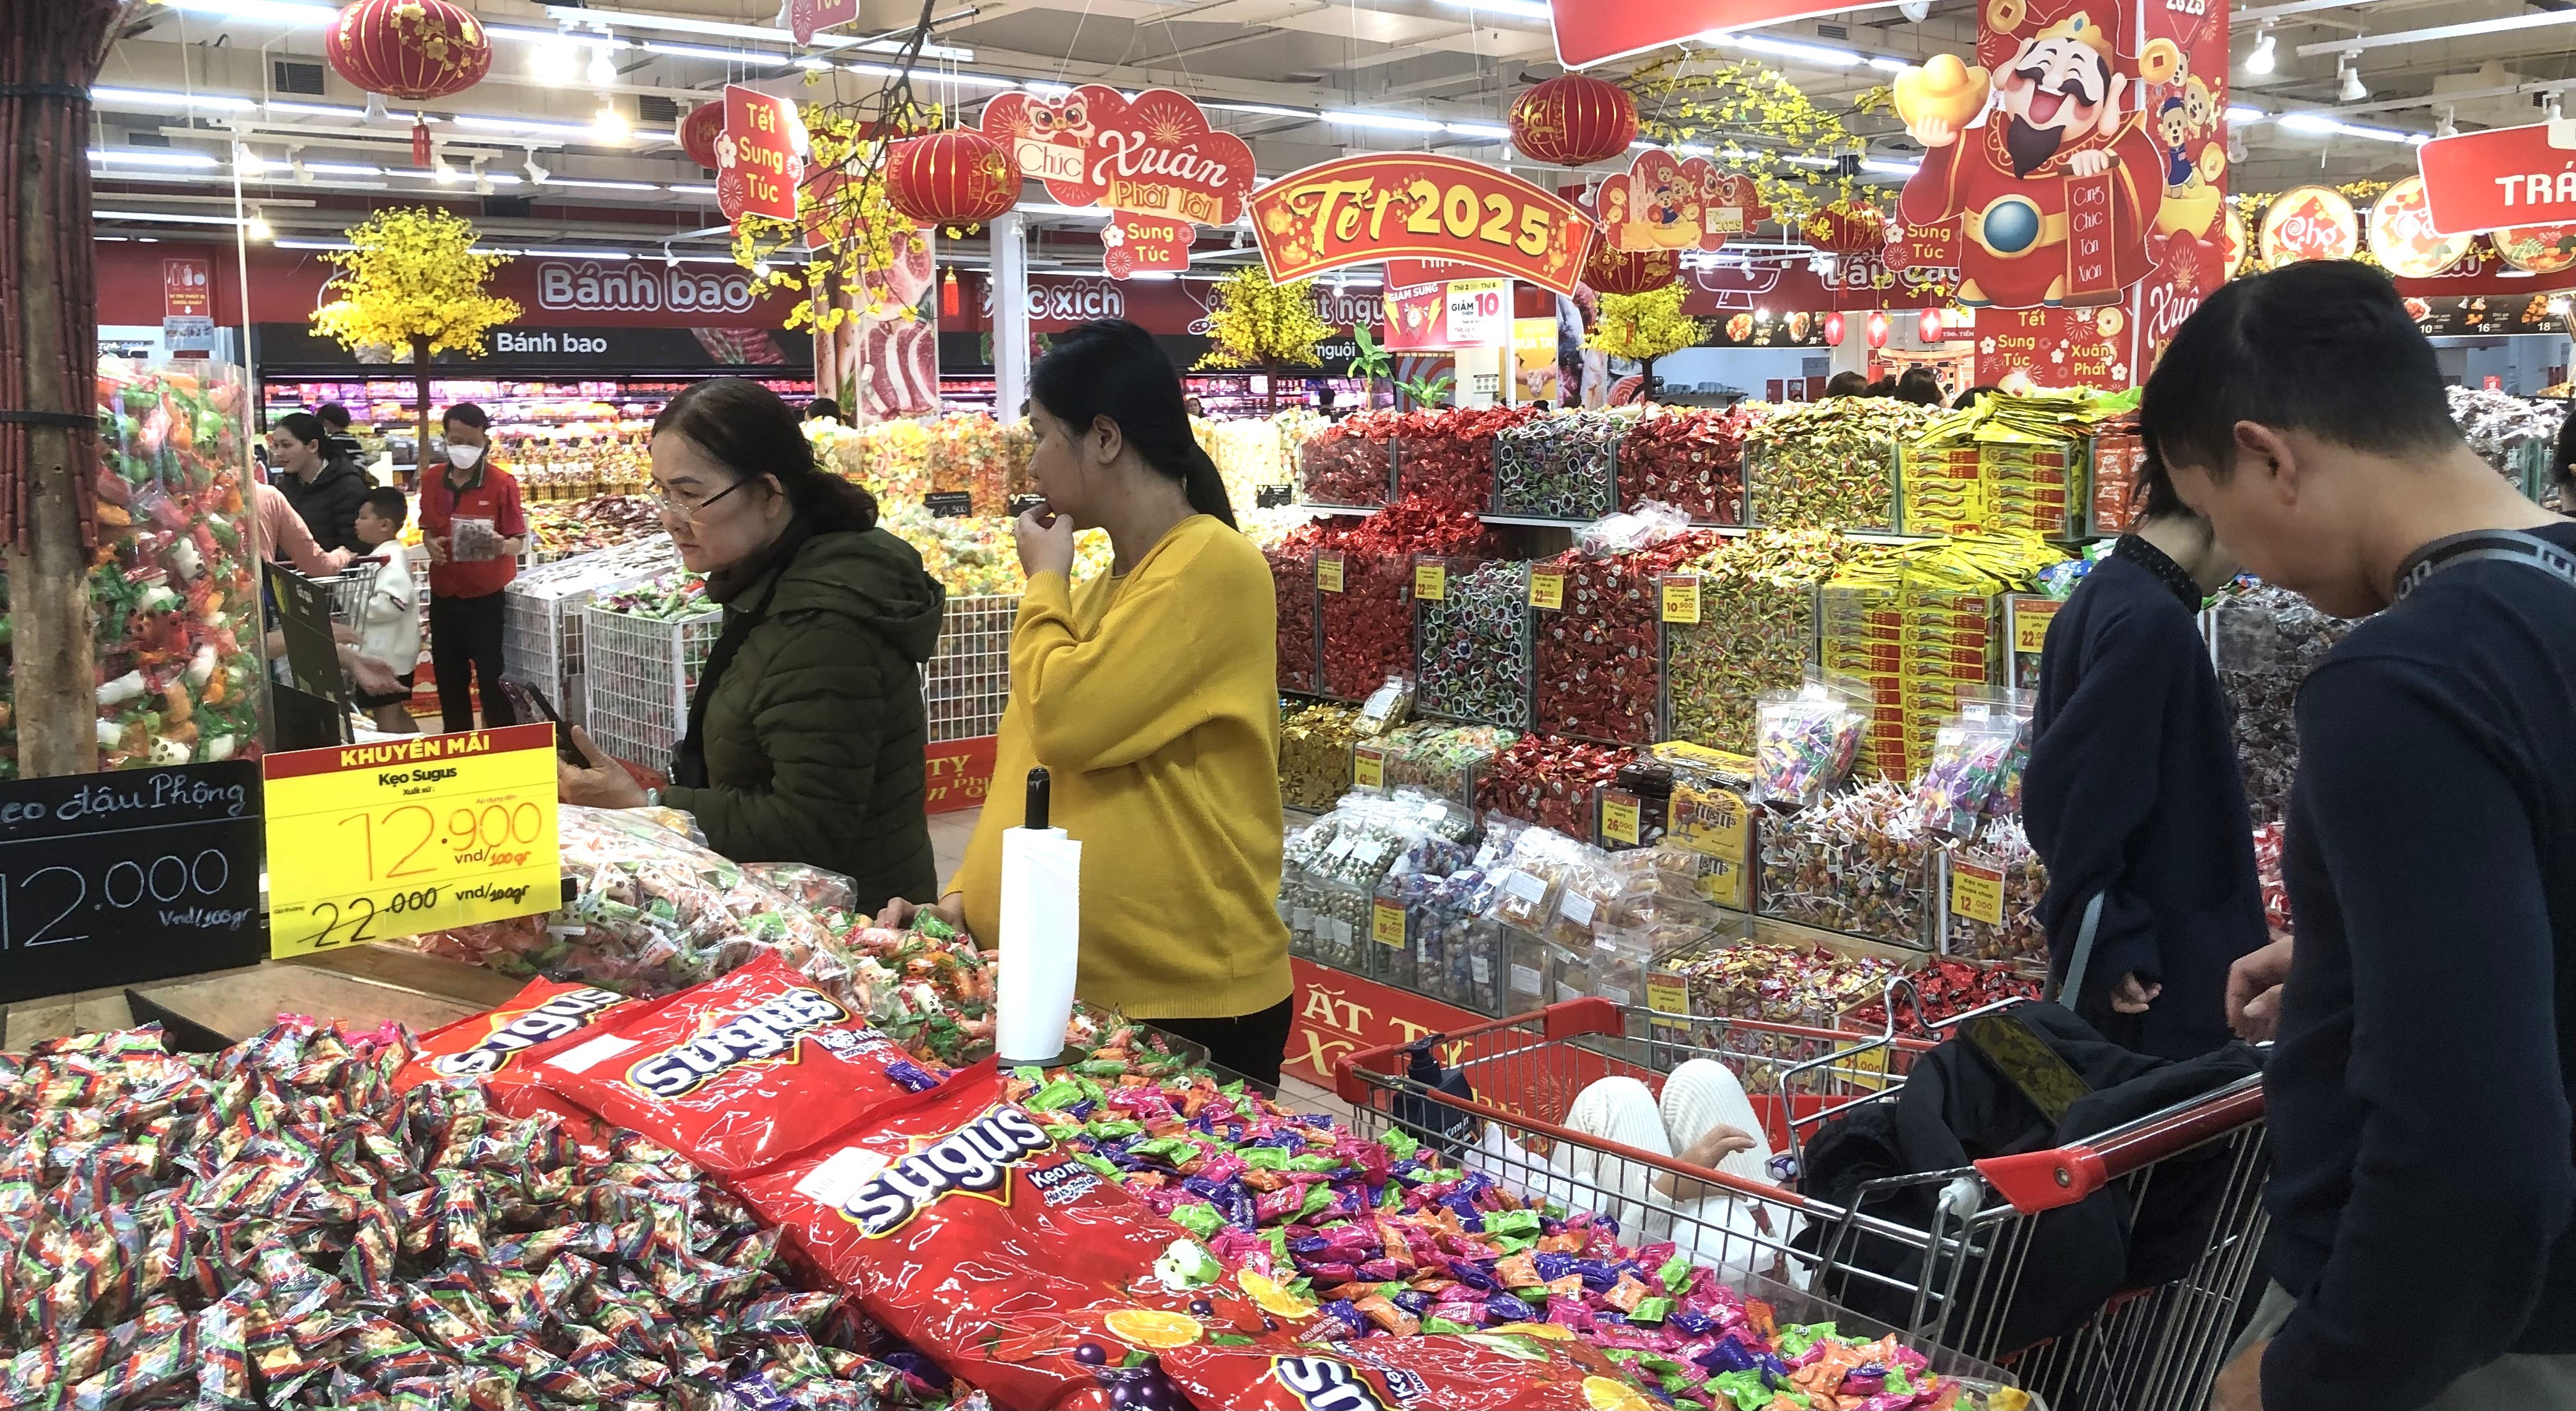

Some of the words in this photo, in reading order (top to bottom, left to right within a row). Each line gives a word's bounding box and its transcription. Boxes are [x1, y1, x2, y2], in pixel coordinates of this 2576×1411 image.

[746, 103, 774, 133] Tết
[739, 136, 783, 175] Sung
[1017, 142, 1083, 178] Chúc
[1092, 130, 1229, 188] Xuân
[746, 172, 779, 203] Túc
[2495, 161, 2576, 206] TRÁ
[1288, 176, 1406, 256] Tết
[1407, 179, 1551, 257] 2025
[1128, 222, 1174, 243] Sung
[1908, 224, 1951, 242] Sung
[2281, 217, 2338, 253] Chợ
[1135, 245, 1170, 263] Túc
[1912, 244, 1944, 259] Túc
[544, 268, 654, 303] Bánh
[671, 271, 749, 306] bao
[1056, 285, 1119, 314] xích
[1451, 300, 1474, 312] GIẢM
[1475, 293, 1499, 317] 10
[2018, 311, 2046, 327] Tết
[2477, 323, 2490, 332] 16
[2538, 322, 2551, 331] 18
[496, 332, 556, 352] Bánh
[563, 333, 607, 353] bao
[1317, 342, 1356, 360] nguội
[1998, 334, 2035, 351] Sung
[2071, 344, 2110, 358] Xuân
[2003, 353, 2030, 367] Túc
[2074, 362, 2106, 376] Phát
[1666, 602, 1694, 613] 10.900
[447, 732, 490, 754] MÃI
[378, 772, 410, 787] Kẹo
[412, 767, 457, 784] Sugus
[56, 784, 146, 818] đậu
[148, 774, 246, 817] Phộng
[338, 802, 542, 882] 12.900
[1958, 885, 1977, 894] chupa
[1964, 878, 1976, 886] Kẹo
[0, 848, 228, 950] 12.000
[1960, 895, 1993, 912] 12.000
[312, 887, 438, 948] 22.000
[1028, 1167, 1068, 1188] Kẹo
